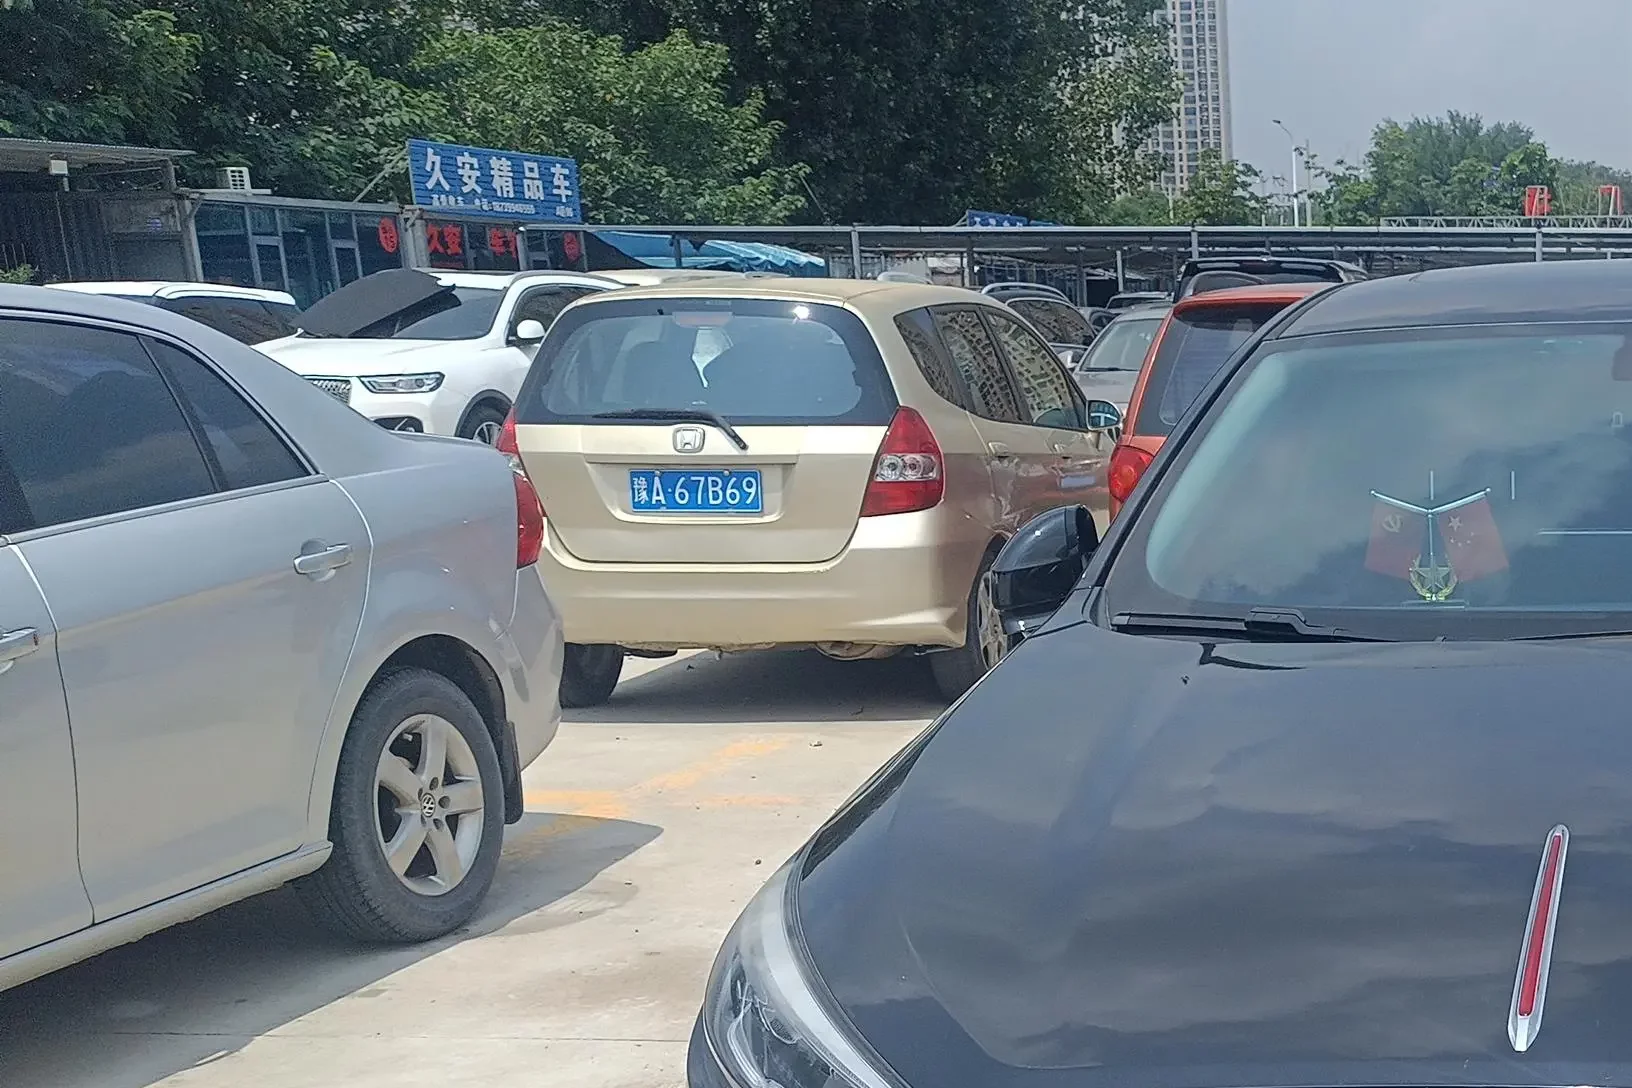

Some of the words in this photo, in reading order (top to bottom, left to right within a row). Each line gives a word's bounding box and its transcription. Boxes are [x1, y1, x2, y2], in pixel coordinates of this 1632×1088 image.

[425, 147, 573, 203] 久安精品车
